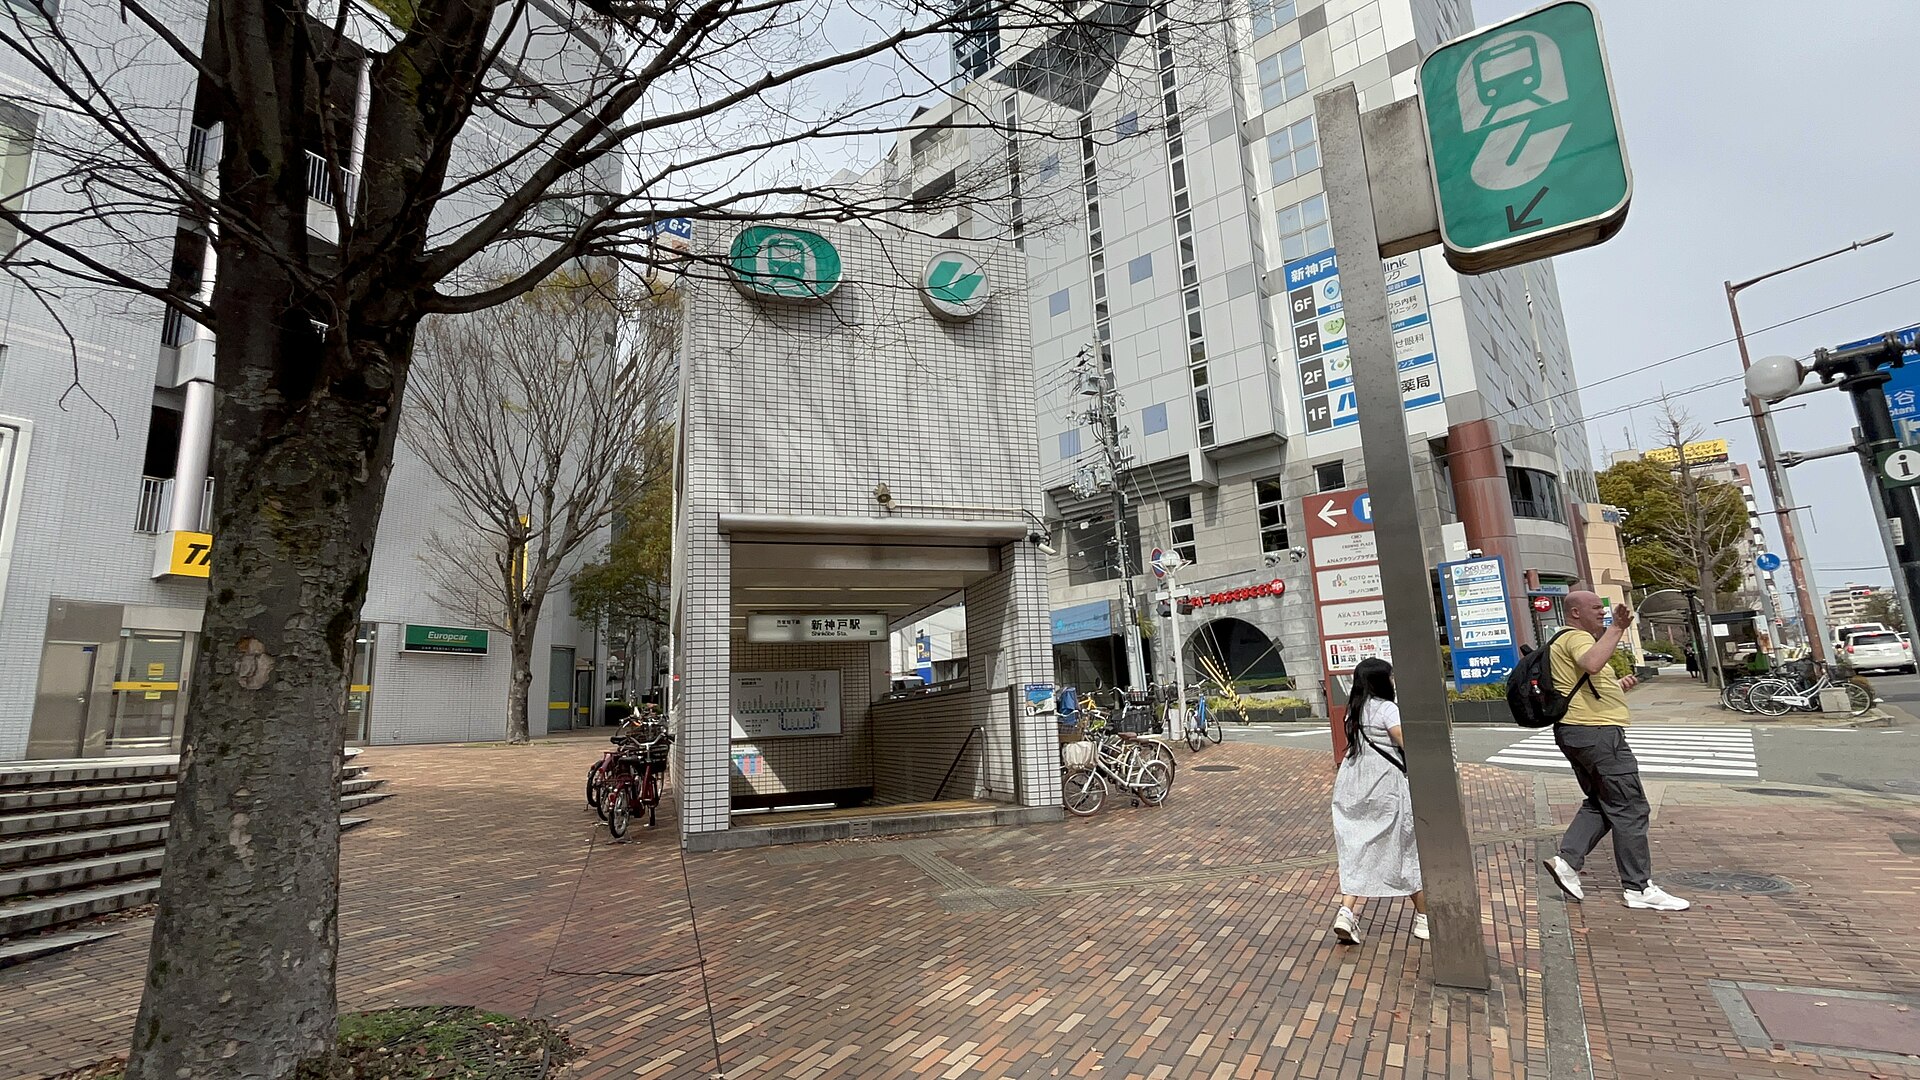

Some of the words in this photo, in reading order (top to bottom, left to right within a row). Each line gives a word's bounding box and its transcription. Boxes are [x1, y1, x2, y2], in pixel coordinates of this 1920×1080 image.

[1291, 255, 1338, 283] 新神戸
[1294, 296, 1313, 313] 6F
[1299, 332, 1317, 348] 5F
[1395, 333, 1424, 348] せ眼科
[1303, 369, 1322, 385] 2F
[1401, 374, 1430, 393] 薬局
[1308, 406, 1327, 421] 1F
[811, 618, 861, 631] 新神戸駅
[427, 630, 469, 643] Europcar
[1468, 655, 1501, 667] 新神戸
[1460, 667, 1513, 680] 医療ゾーン
